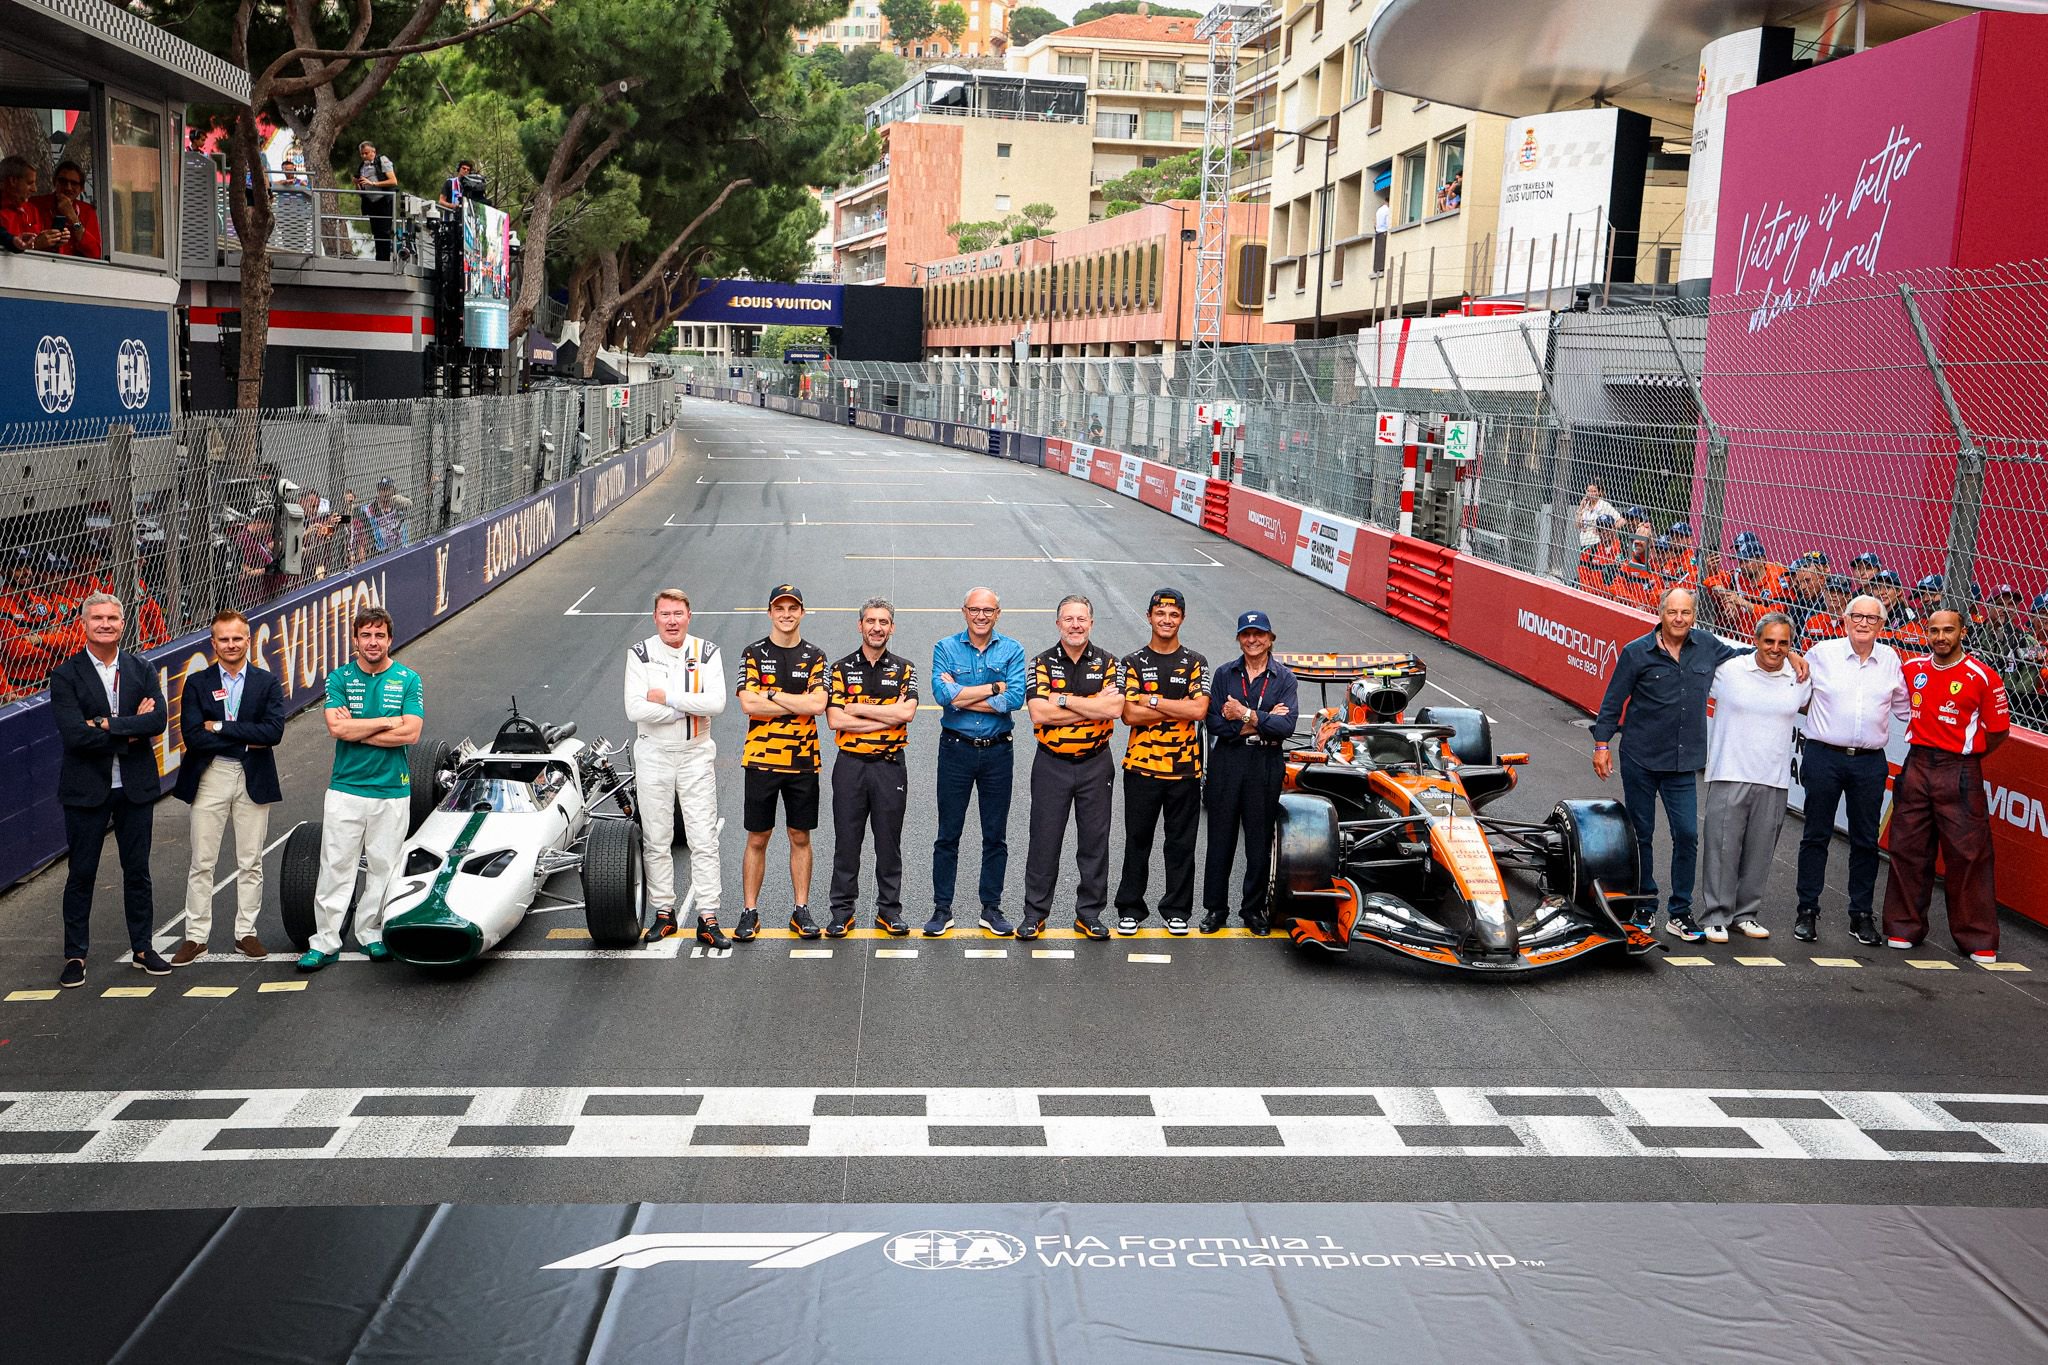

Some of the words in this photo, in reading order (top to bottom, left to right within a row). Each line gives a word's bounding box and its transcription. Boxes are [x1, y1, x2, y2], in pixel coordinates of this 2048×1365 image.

[1520, 189, 1553, 201] VUITTON
[1546, 180, 1554, 189] IN
[1735, 201, 1810, 295] Victory
[1818, 193, 1843, 231] is
[1846, 124, 1922, 219] better
[1748, 277, 1802, 335] when
[1807, 200, 1892, 309] shared
[733, 295, 773, 309] LOUIS
[775, 297, 832, 311] VUITTON
[904, 418, 917, 436] LOUIS
[917, 421, 935, 440] VUITTON
[954, 426, 969, 446] LOUIS
[969, 428, 989, 451] VUITTON
[485, 512, 519, 584] LOUIS
[519, 494, 556, 559] VUITTON
[1518, 608, 1607, 662] MONACOCIRCUIT
[1567, 654, 1584, 670] SINCE
[1584, 660, 1598, 676] 1929
[1034, 1235, 1111, 1250] FIA
[1118, 1235, 1312, 1250] Formula
[1314, 1235, 1344, 1250] 1
[1037, 1251, 1178, 1267] World
[1186, 1250, 1518, 1269] Championship
